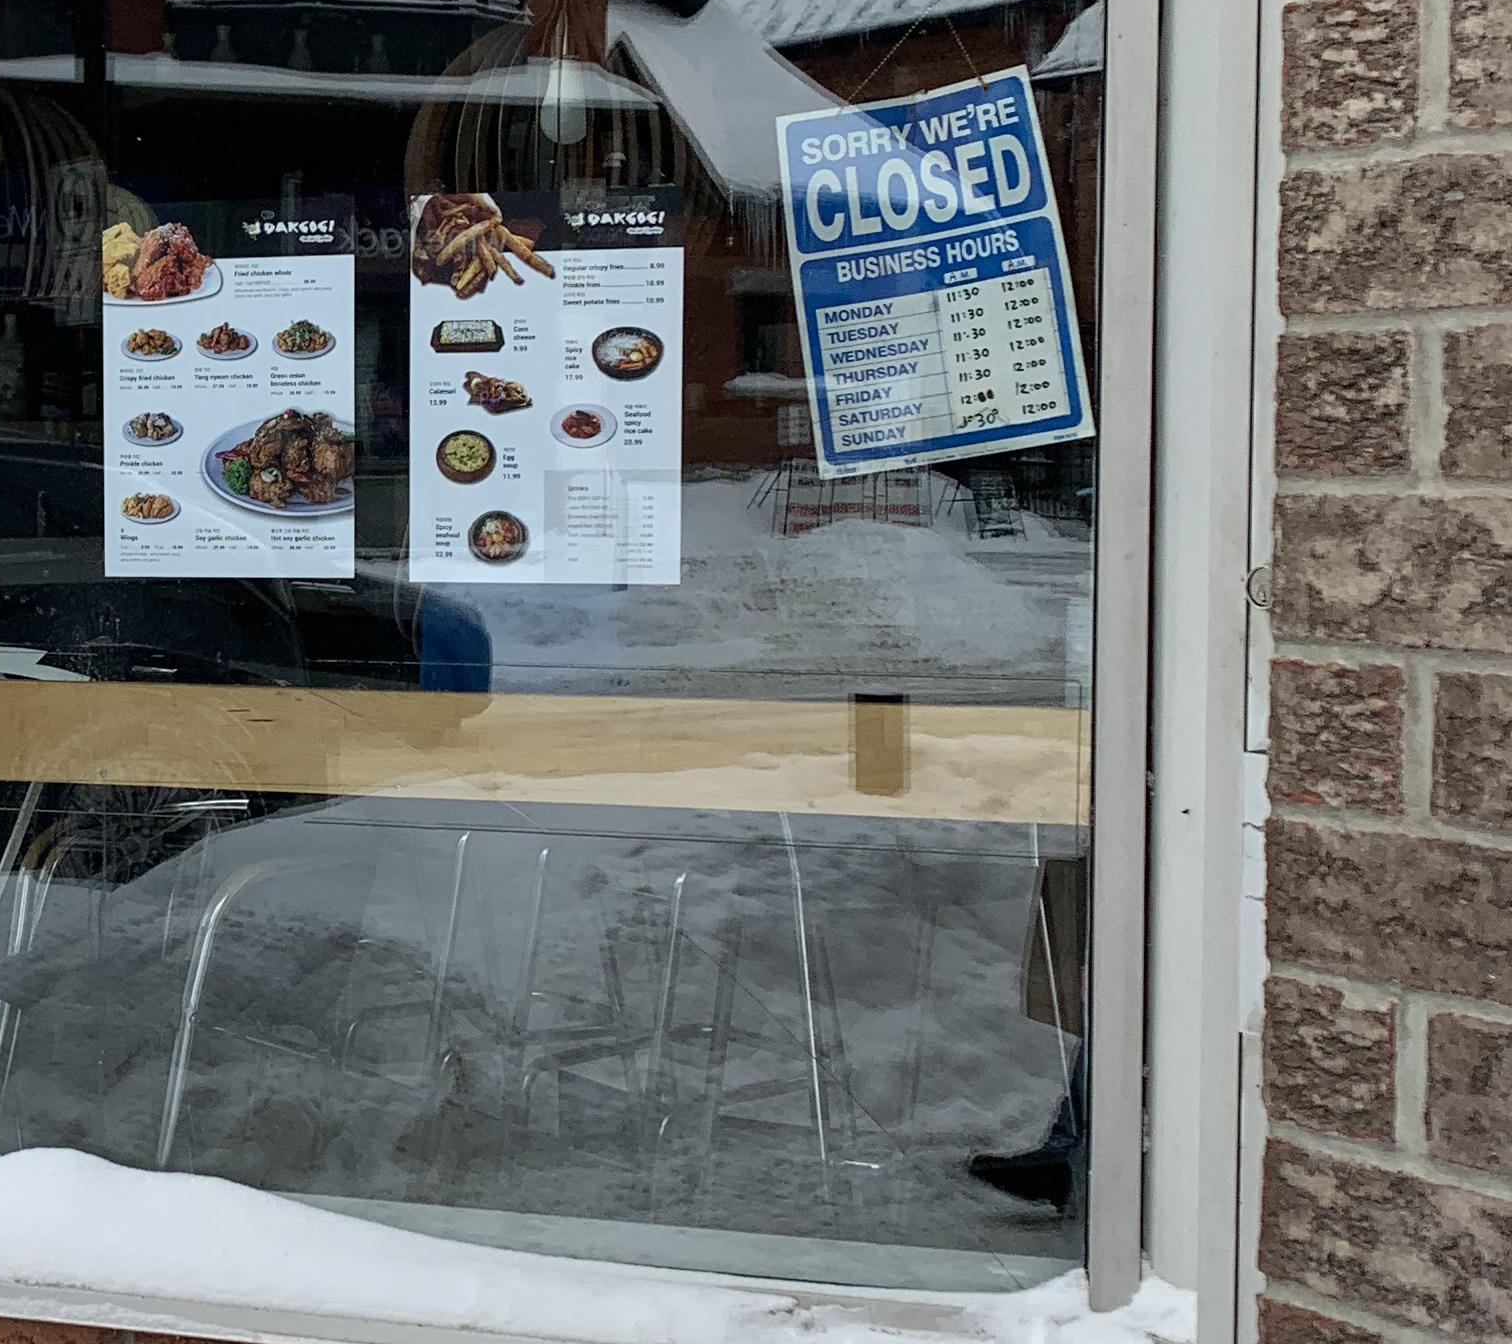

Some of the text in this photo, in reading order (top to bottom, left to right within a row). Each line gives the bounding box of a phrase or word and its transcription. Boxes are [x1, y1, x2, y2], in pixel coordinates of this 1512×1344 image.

[801, 97, 1019, 164] SORRY WE'RE
[805, 133, 1032, 242] CLOSED
[837, 229, 1020, 284] BUSINESS HOURS
[824, 303, 893, 324] MONDAY
[828, 323, 899, 344] TUESDAY
[951, 307, 984, 323] 11:30
[830, 339, 929, 365] WEDNESDAY
[833, 361, 919, 385] THURSDAY
[835, 387, 892, 406] FRIDAY
[838, 402, 923, 427] SATURDAY
[841, 426, 906, 447] SUNDAY
